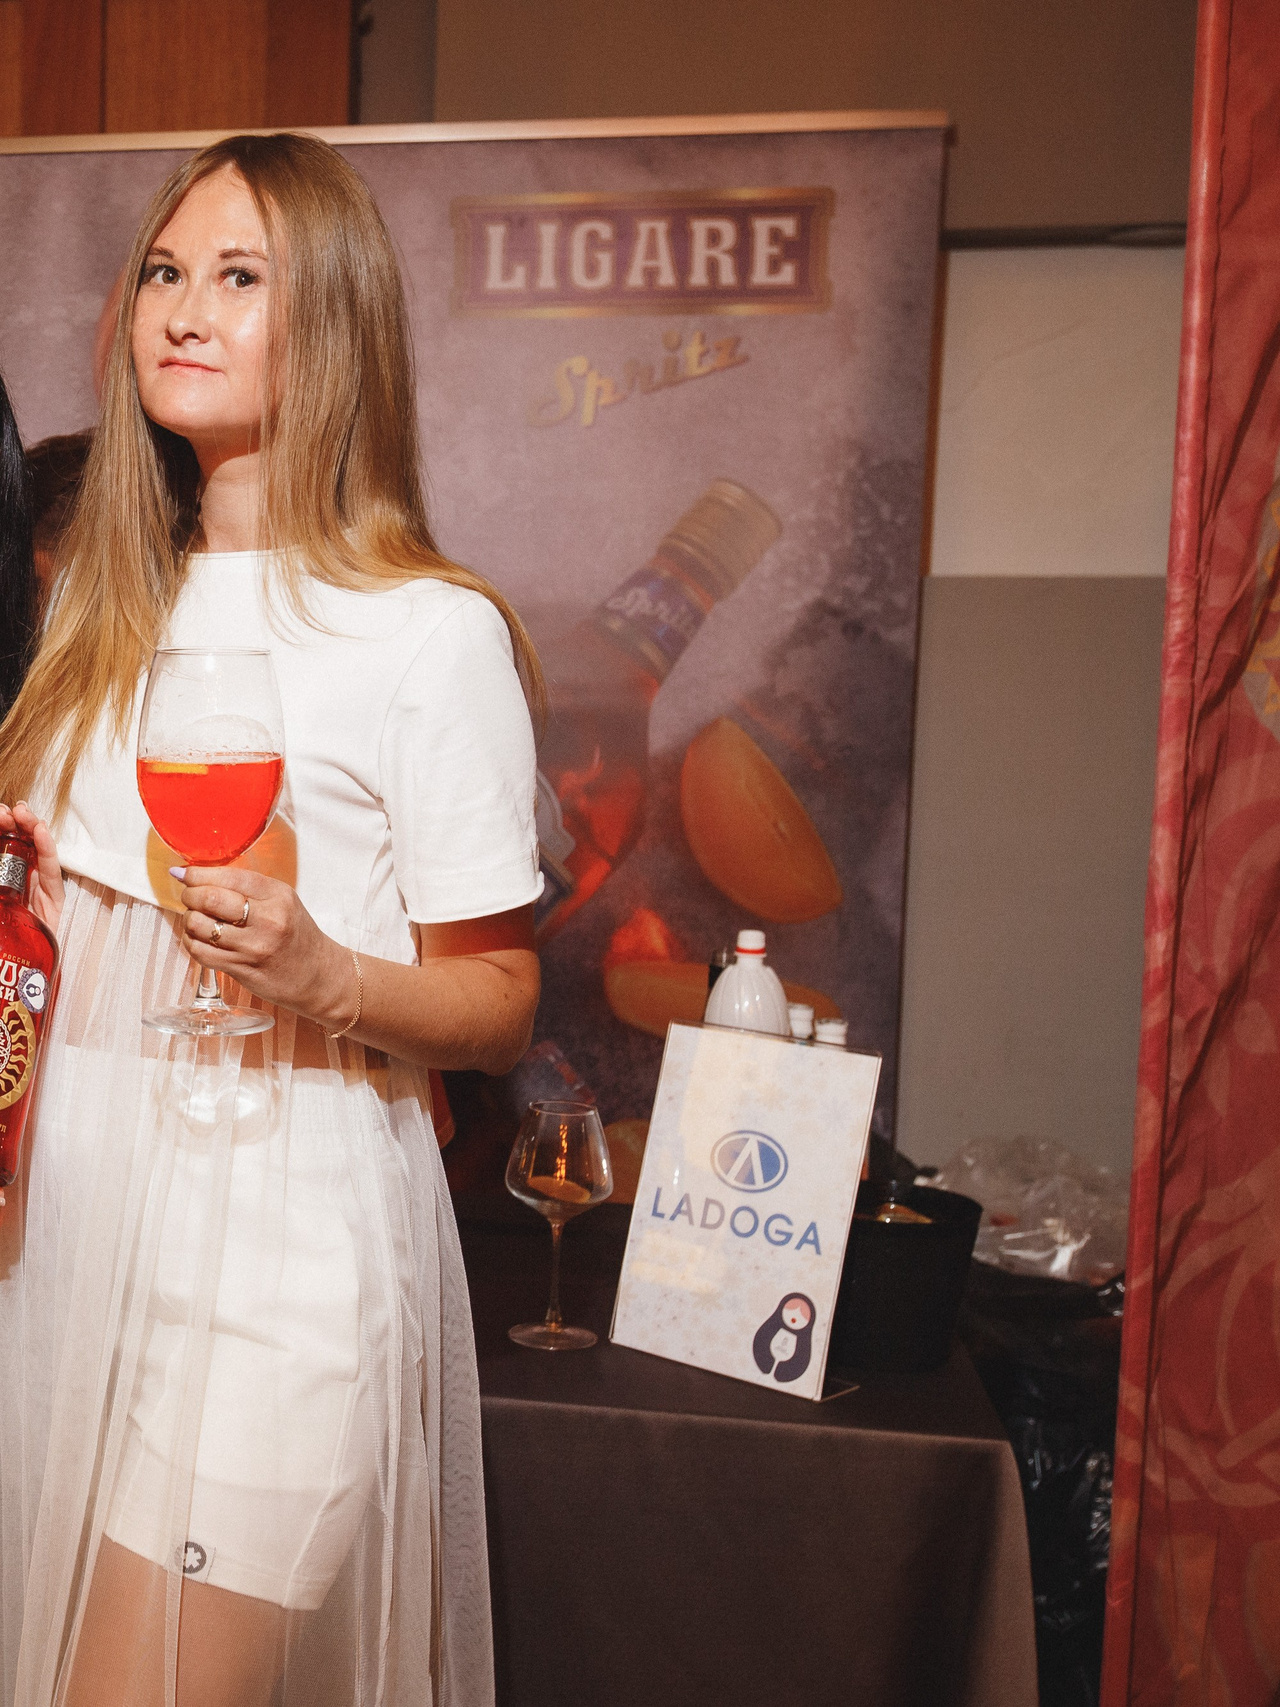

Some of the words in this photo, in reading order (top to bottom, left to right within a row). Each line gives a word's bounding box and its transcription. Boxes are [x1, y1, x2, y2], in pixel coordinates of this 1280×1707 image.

[484, 216, 797, 290] LIGARE
[526, 331, 750, 428] Spritz
[651, 1187, 822, 1255] LADOGA
